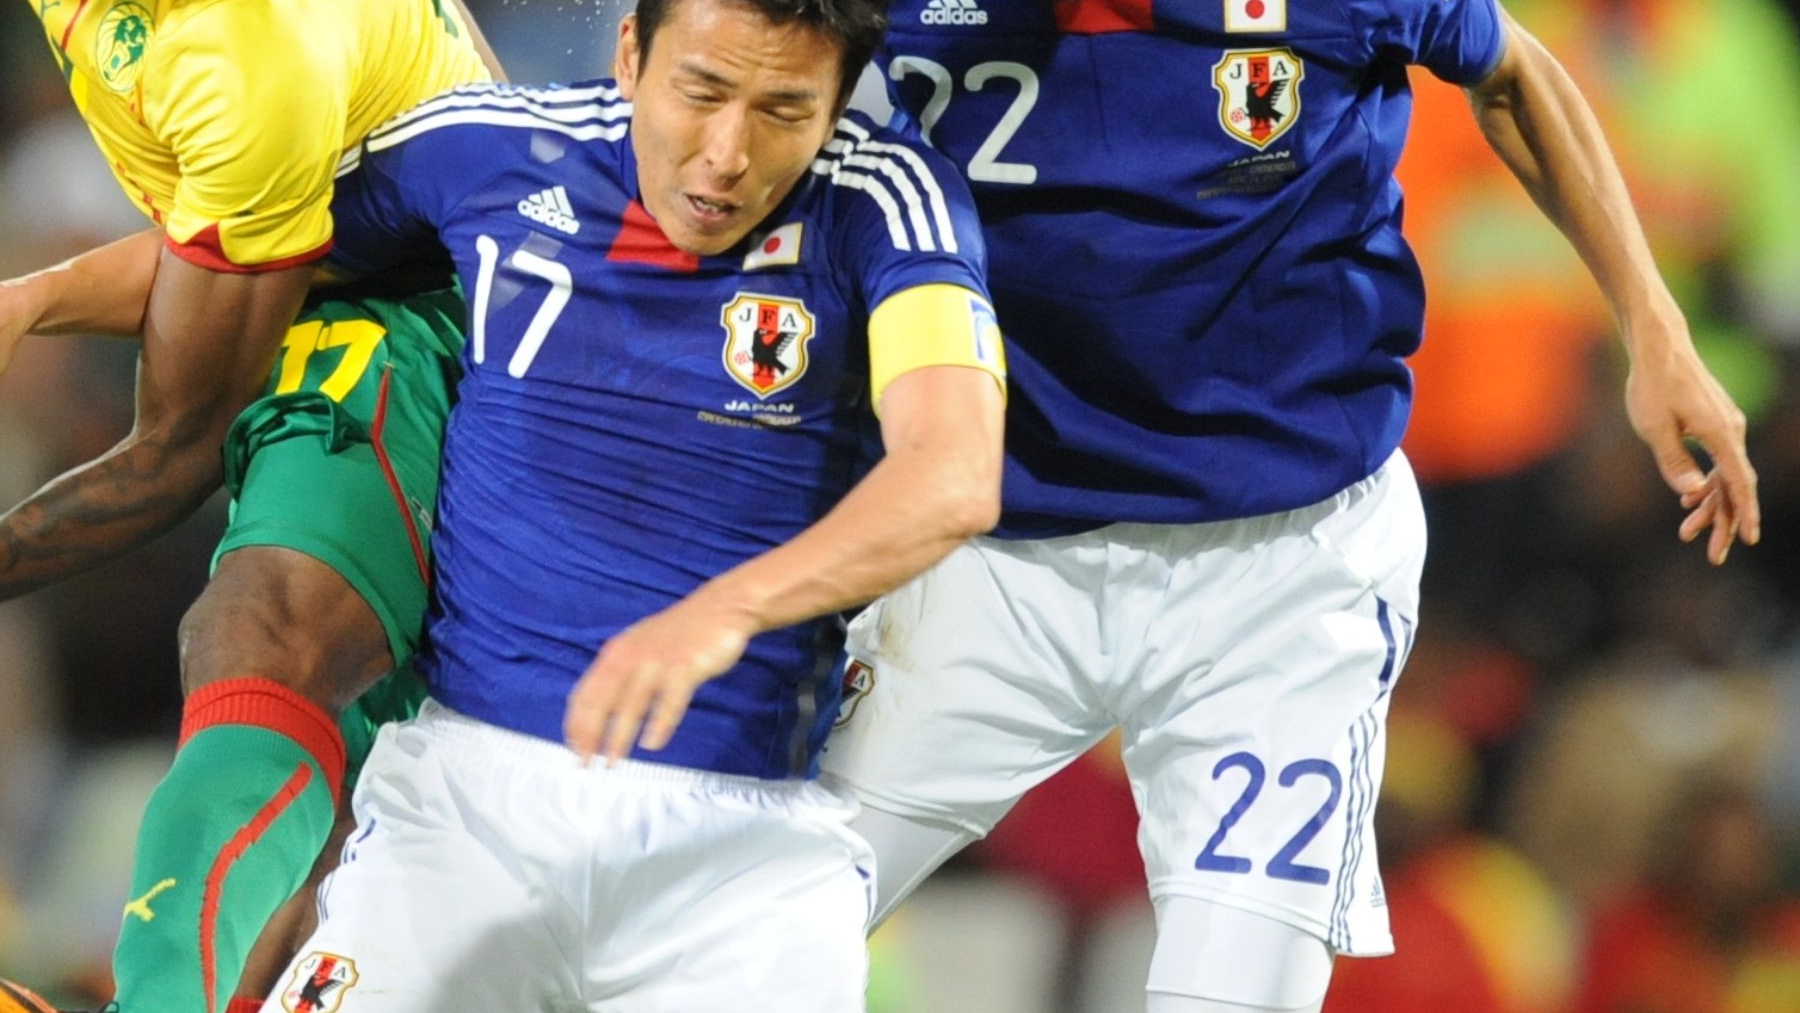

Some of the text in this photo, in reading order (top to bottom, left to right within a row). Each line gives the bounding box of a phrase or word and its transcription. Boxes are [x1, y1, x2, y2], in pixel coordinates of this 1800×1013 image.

[920, 6, 988, 25] adidas
[1230, 60, 1288, 80] JFA
[889, 55, 1039, 185] 22
[517, 199, 580, 235] adidas
[473, 234, 573, 379] 17
[739, 307, 797, 328] JFA
[275, 319, 387, 403] 17
[724, 399, 794, 413] JAPAN
[1194, 751, 1343, 887] 22
